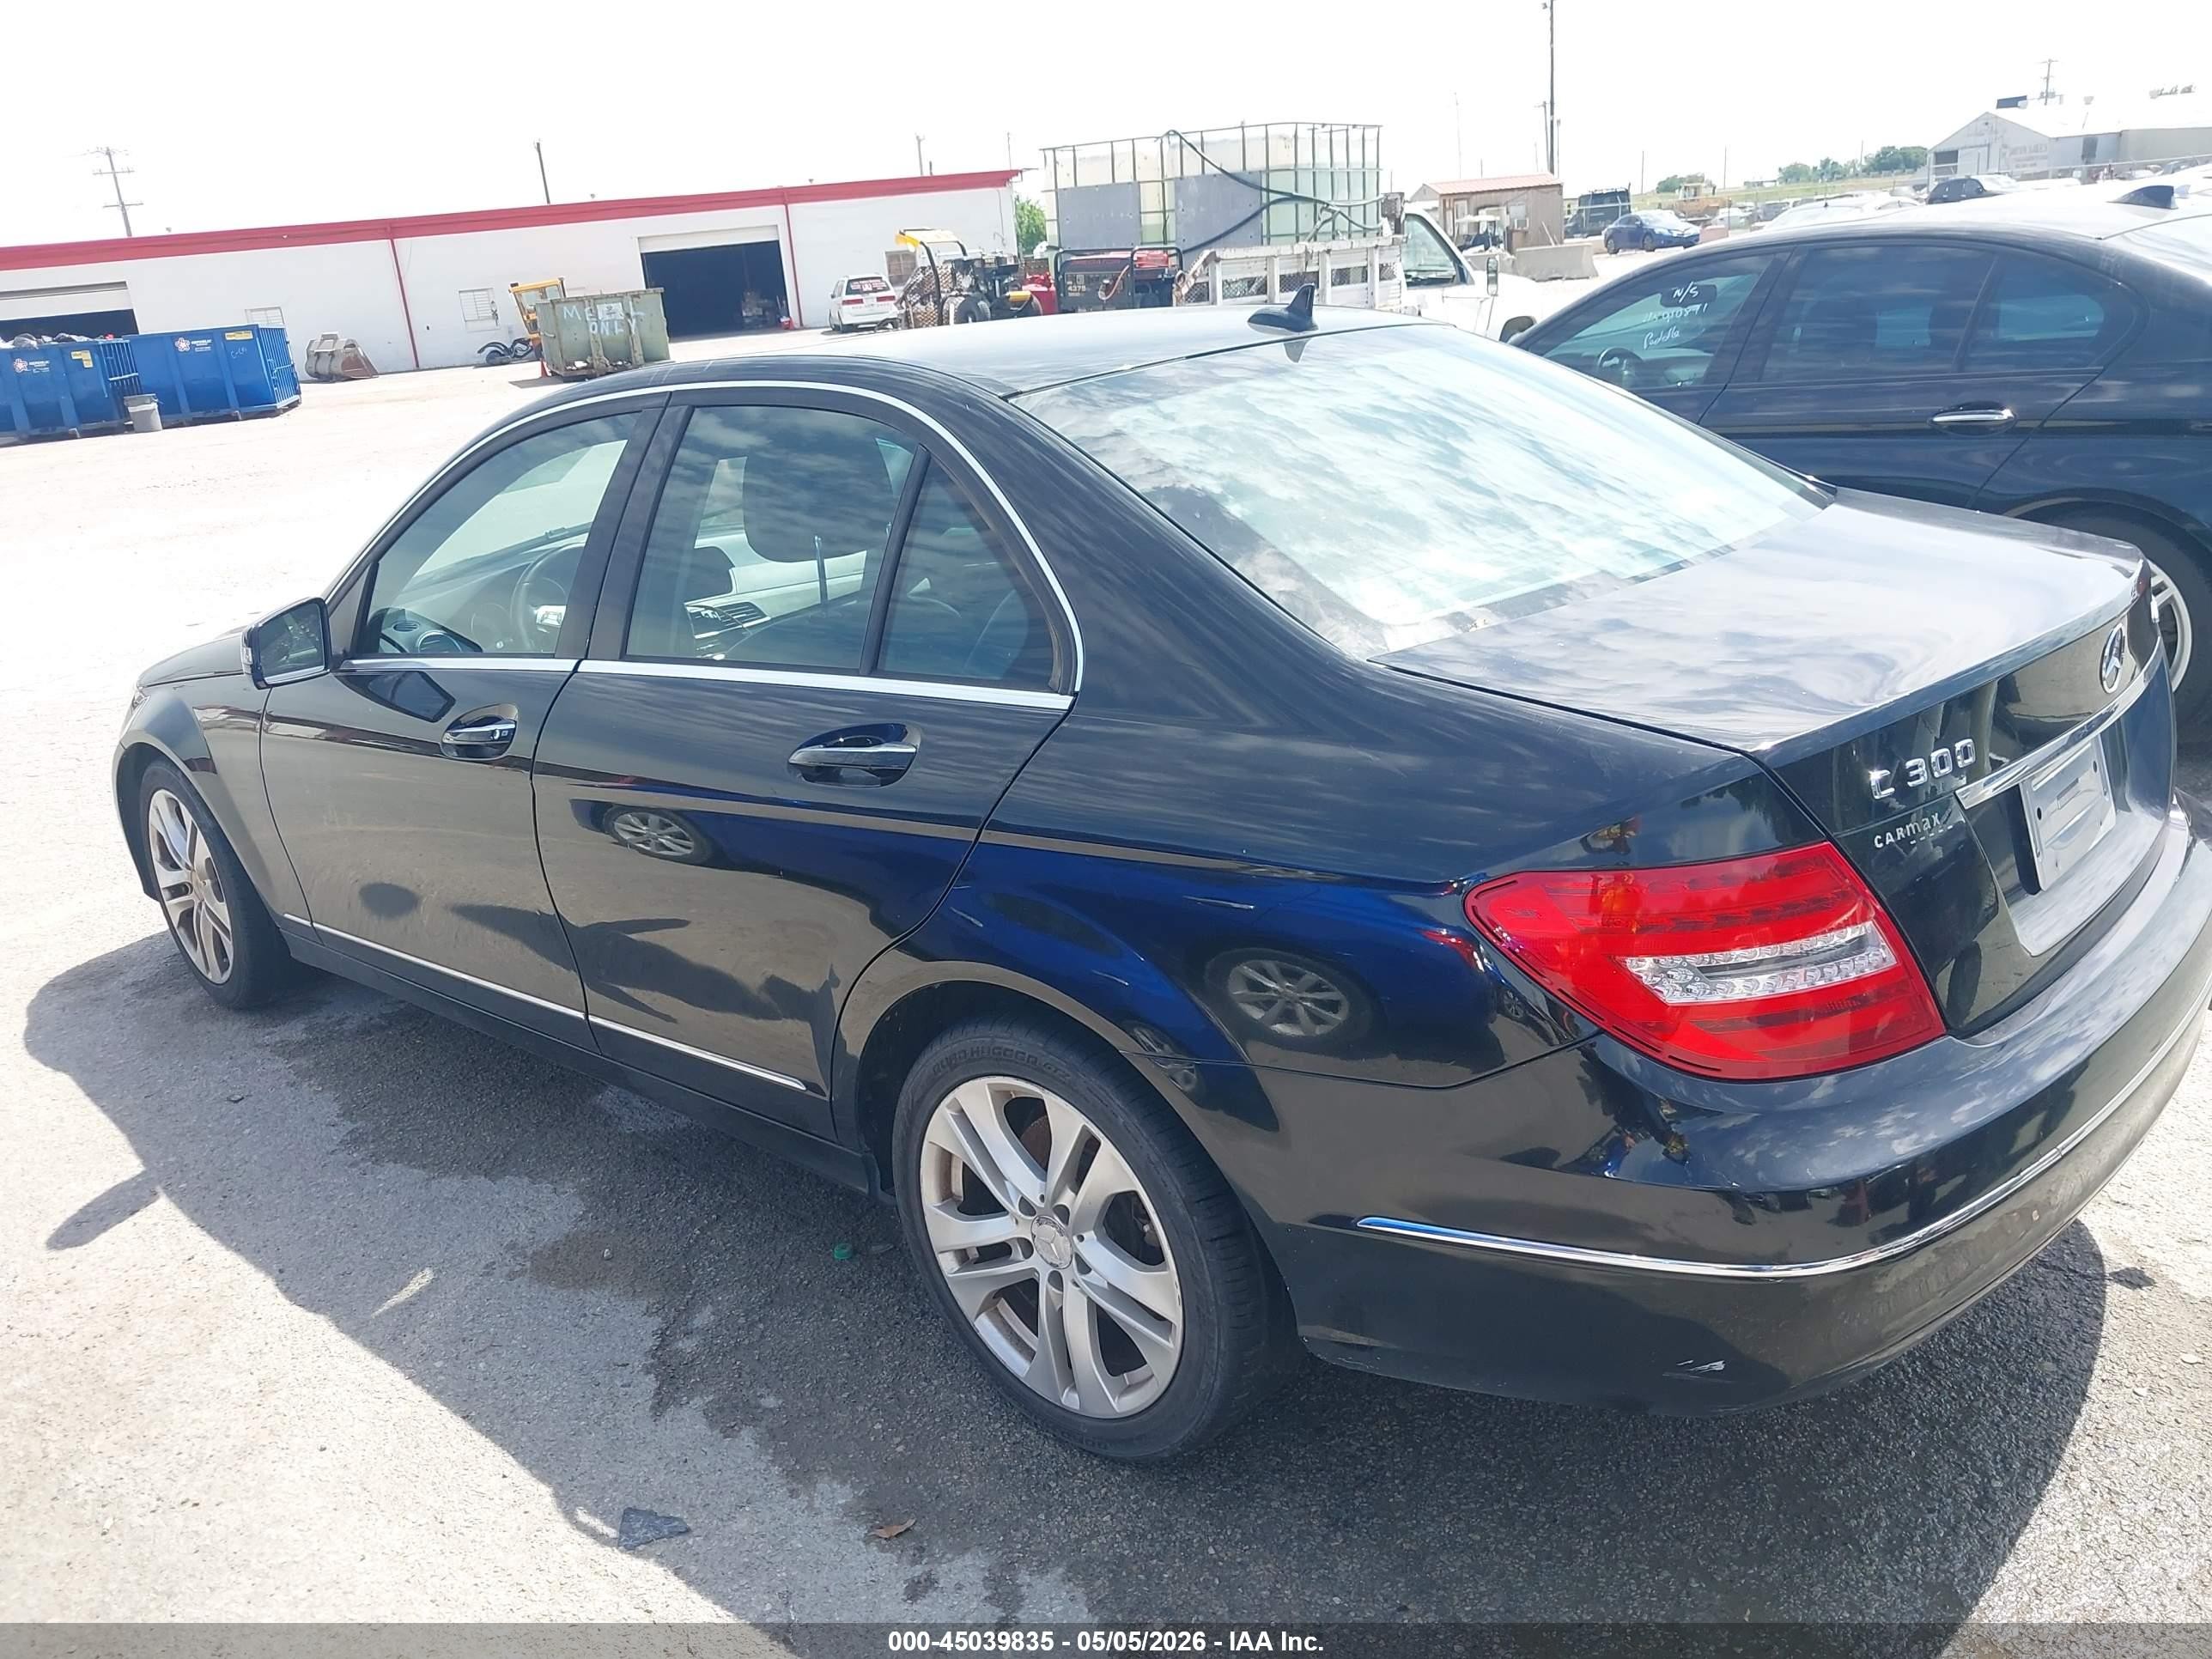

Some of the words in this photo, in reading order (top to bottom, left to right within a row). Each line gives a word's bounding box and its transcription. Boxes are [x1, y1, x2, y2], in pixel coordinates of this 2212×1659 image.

[1673, 281, 1699, 303] N/S
[562, 301, 647, 322] MEL
[1869, 769, 1896, 799] C
[1905, 738, 1977, 788] 300
